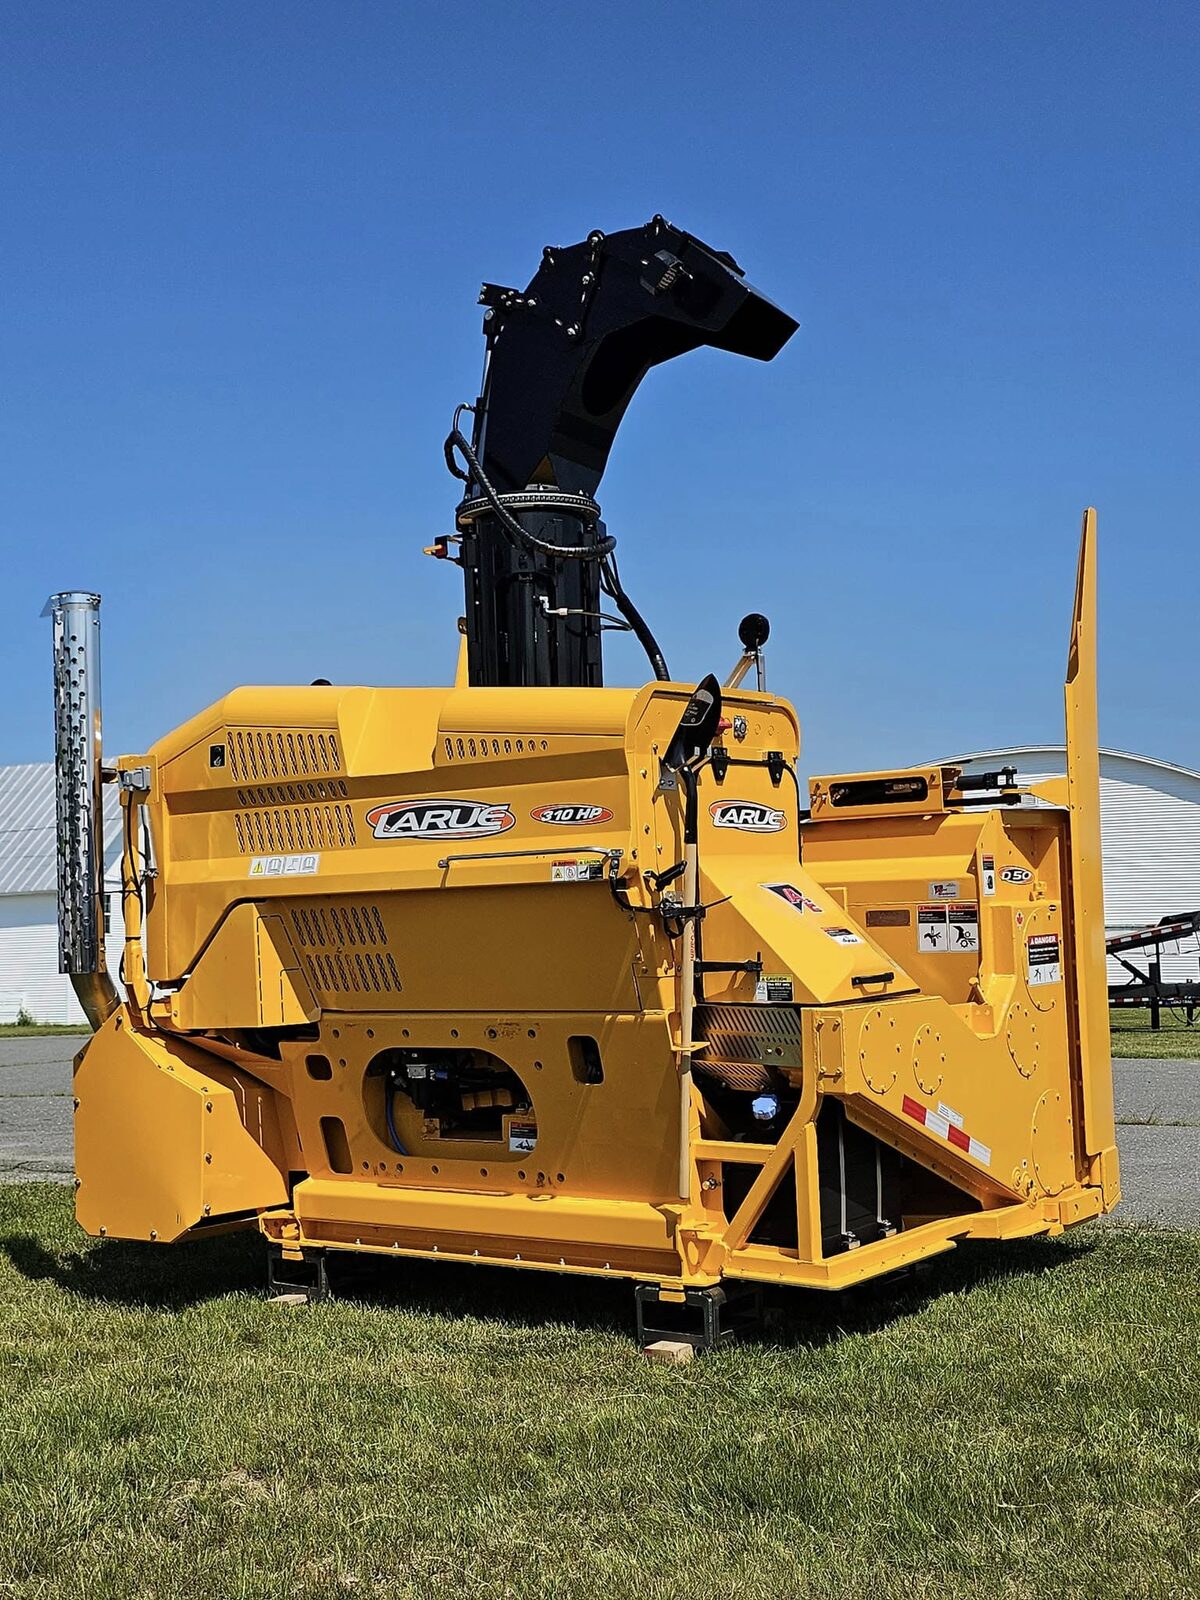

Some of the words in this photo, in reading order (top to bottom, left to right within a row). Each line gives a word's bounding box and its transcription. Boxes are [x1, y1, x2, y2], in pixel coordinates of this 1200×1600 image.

[373, 803, 510, 839] LARUE
[540, 808, 574, 822] 310
[575, 807, 603, 820] HP
[712, 807, 784, 828] LARUE
[1034, 935, 1057, 944] DANGER
